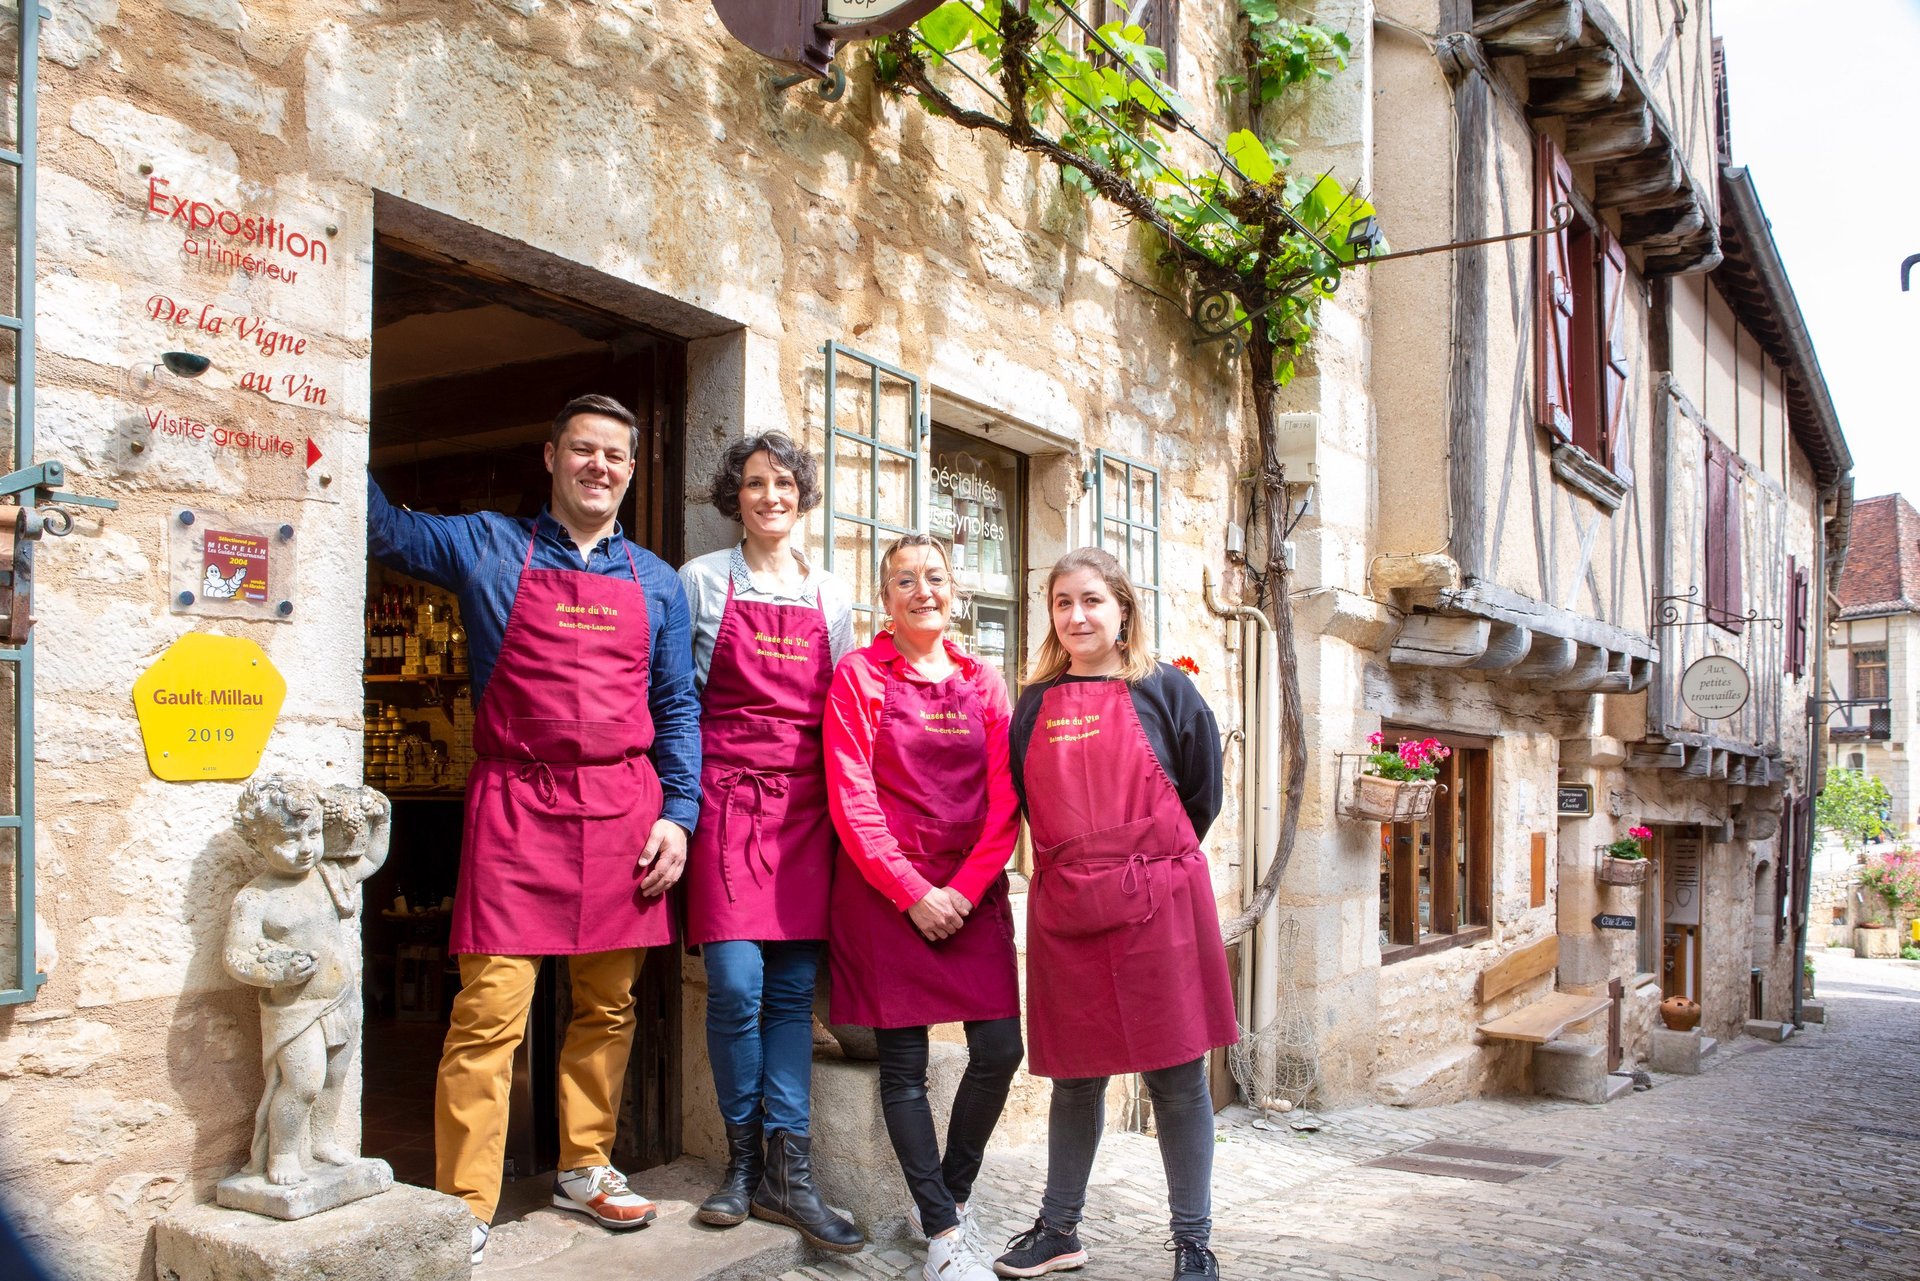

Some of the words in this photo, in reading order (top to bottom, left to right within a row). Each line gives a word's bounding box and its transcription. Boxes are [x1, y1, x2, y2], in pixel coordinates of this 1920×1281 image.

[149, 176, 327, 265] Exposition
[183, 236, 199, 254] à
[207, 239, 298, 285] l'intérieur
[146, 294, 188, 325] De
[199, 304, 223, 334] la
[232, 316, 307, 357] Vigne
[240, 371, 272, 393] au
[282, 373, 328, 405] Vin
[145, 407, 206, 439] Visite
[213, 425, 295, 457] gratuite
[929, 466, 997, 502] pécialités
[208, 542, 266, 555] MICHELIN
[229, 557, 248, 565] 2004
[556, 603, 585, 613] Musée
[588, 605, 599, 614] du
[602, 606, 618, 616] Vin
[755, 632, 781, 643] Musée
[783, 636, 793, 645] du
[796, 637, 809, 647] Vin
[1703, 664, 1727, 675] Aux
[1699, 679, 1732, 690] petites
[1691, 690, 1742, 701] trouvailles
[920, 710, 944, 720] Musée
[946, 710, 956, 719] du
[1046, 717, 1070, 729] Musée
[1072, 716, 1082, 725] du
[1085, 714, 1100, 724] Vin
[187, 728, 234, 742] 2019
